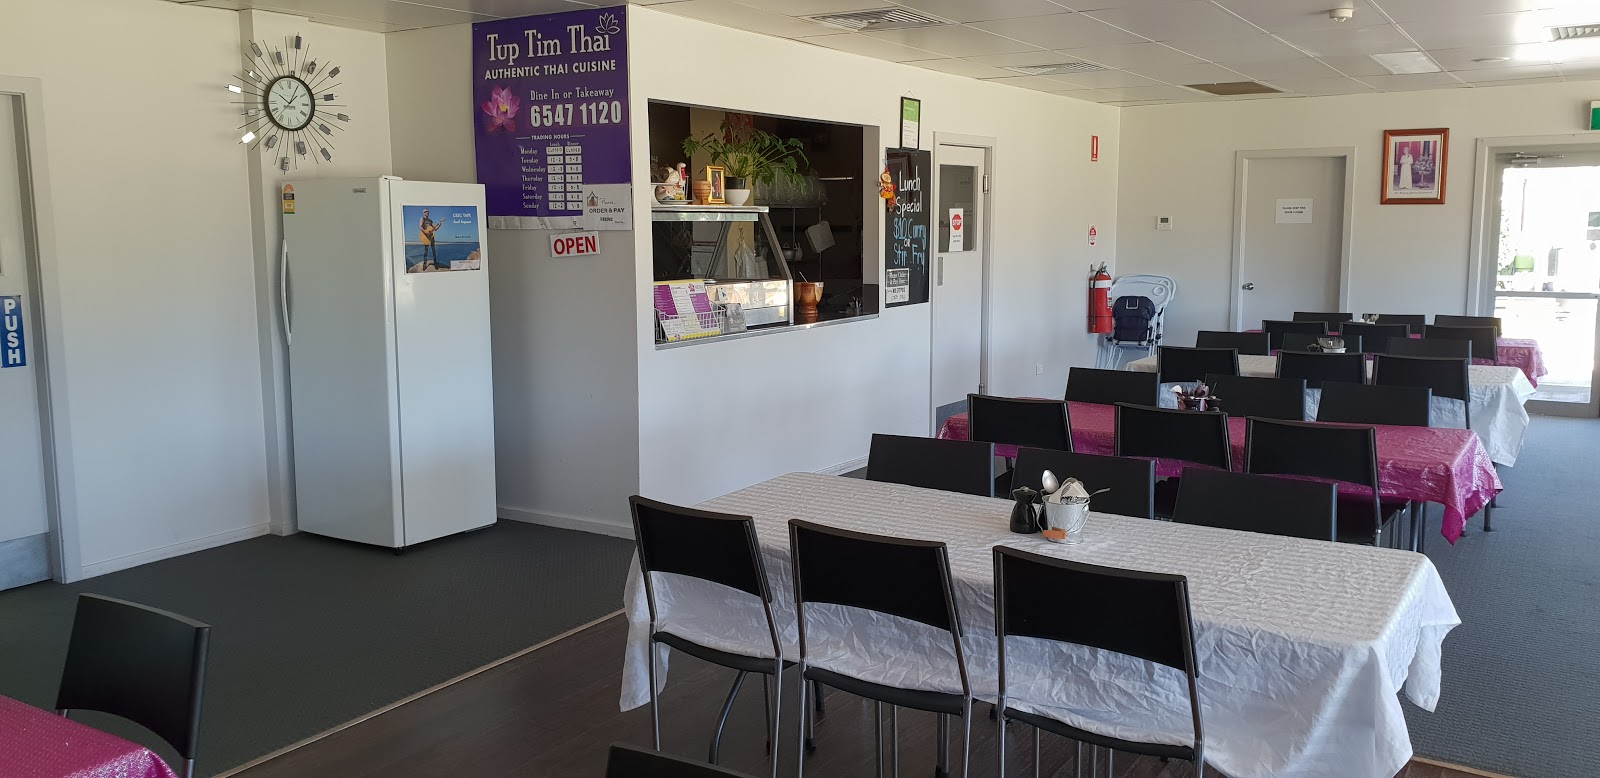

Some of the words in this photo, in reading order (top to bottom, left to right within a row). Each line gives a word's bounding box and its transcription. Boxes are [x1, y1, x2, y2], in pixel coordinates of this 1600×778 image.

[486, 34, 520, 65] Tup
[524, 30, 562, 58] Tim
[567, 25, 610, 54] Thai
[485, 66, 540, 80] AUTHENTIC
[544, 64, 568, 75] THAI
[573, 60, 616, 73] CUISINE
[530, 90, 548, 100] Dine
[551, 89, 559, 99] In
[563, 91, 572, 99] or
[576, 87, 614, 98] Takeaway
[530, 104, 574, 128] 6547
[580, 101, 622, 125] 1120
[899, 166, 920, 191] Lunch
[896, 191, 922, 217] Special
[554, 236, 596, 255] OPEN
[904, 238, 910, 248] OR
[908, 218, 926, 250] Curry
[894, 243, 907, 266] Stir
[912, 244, 925, 274] Fry
[4, 299, 21, 364] PUSH
